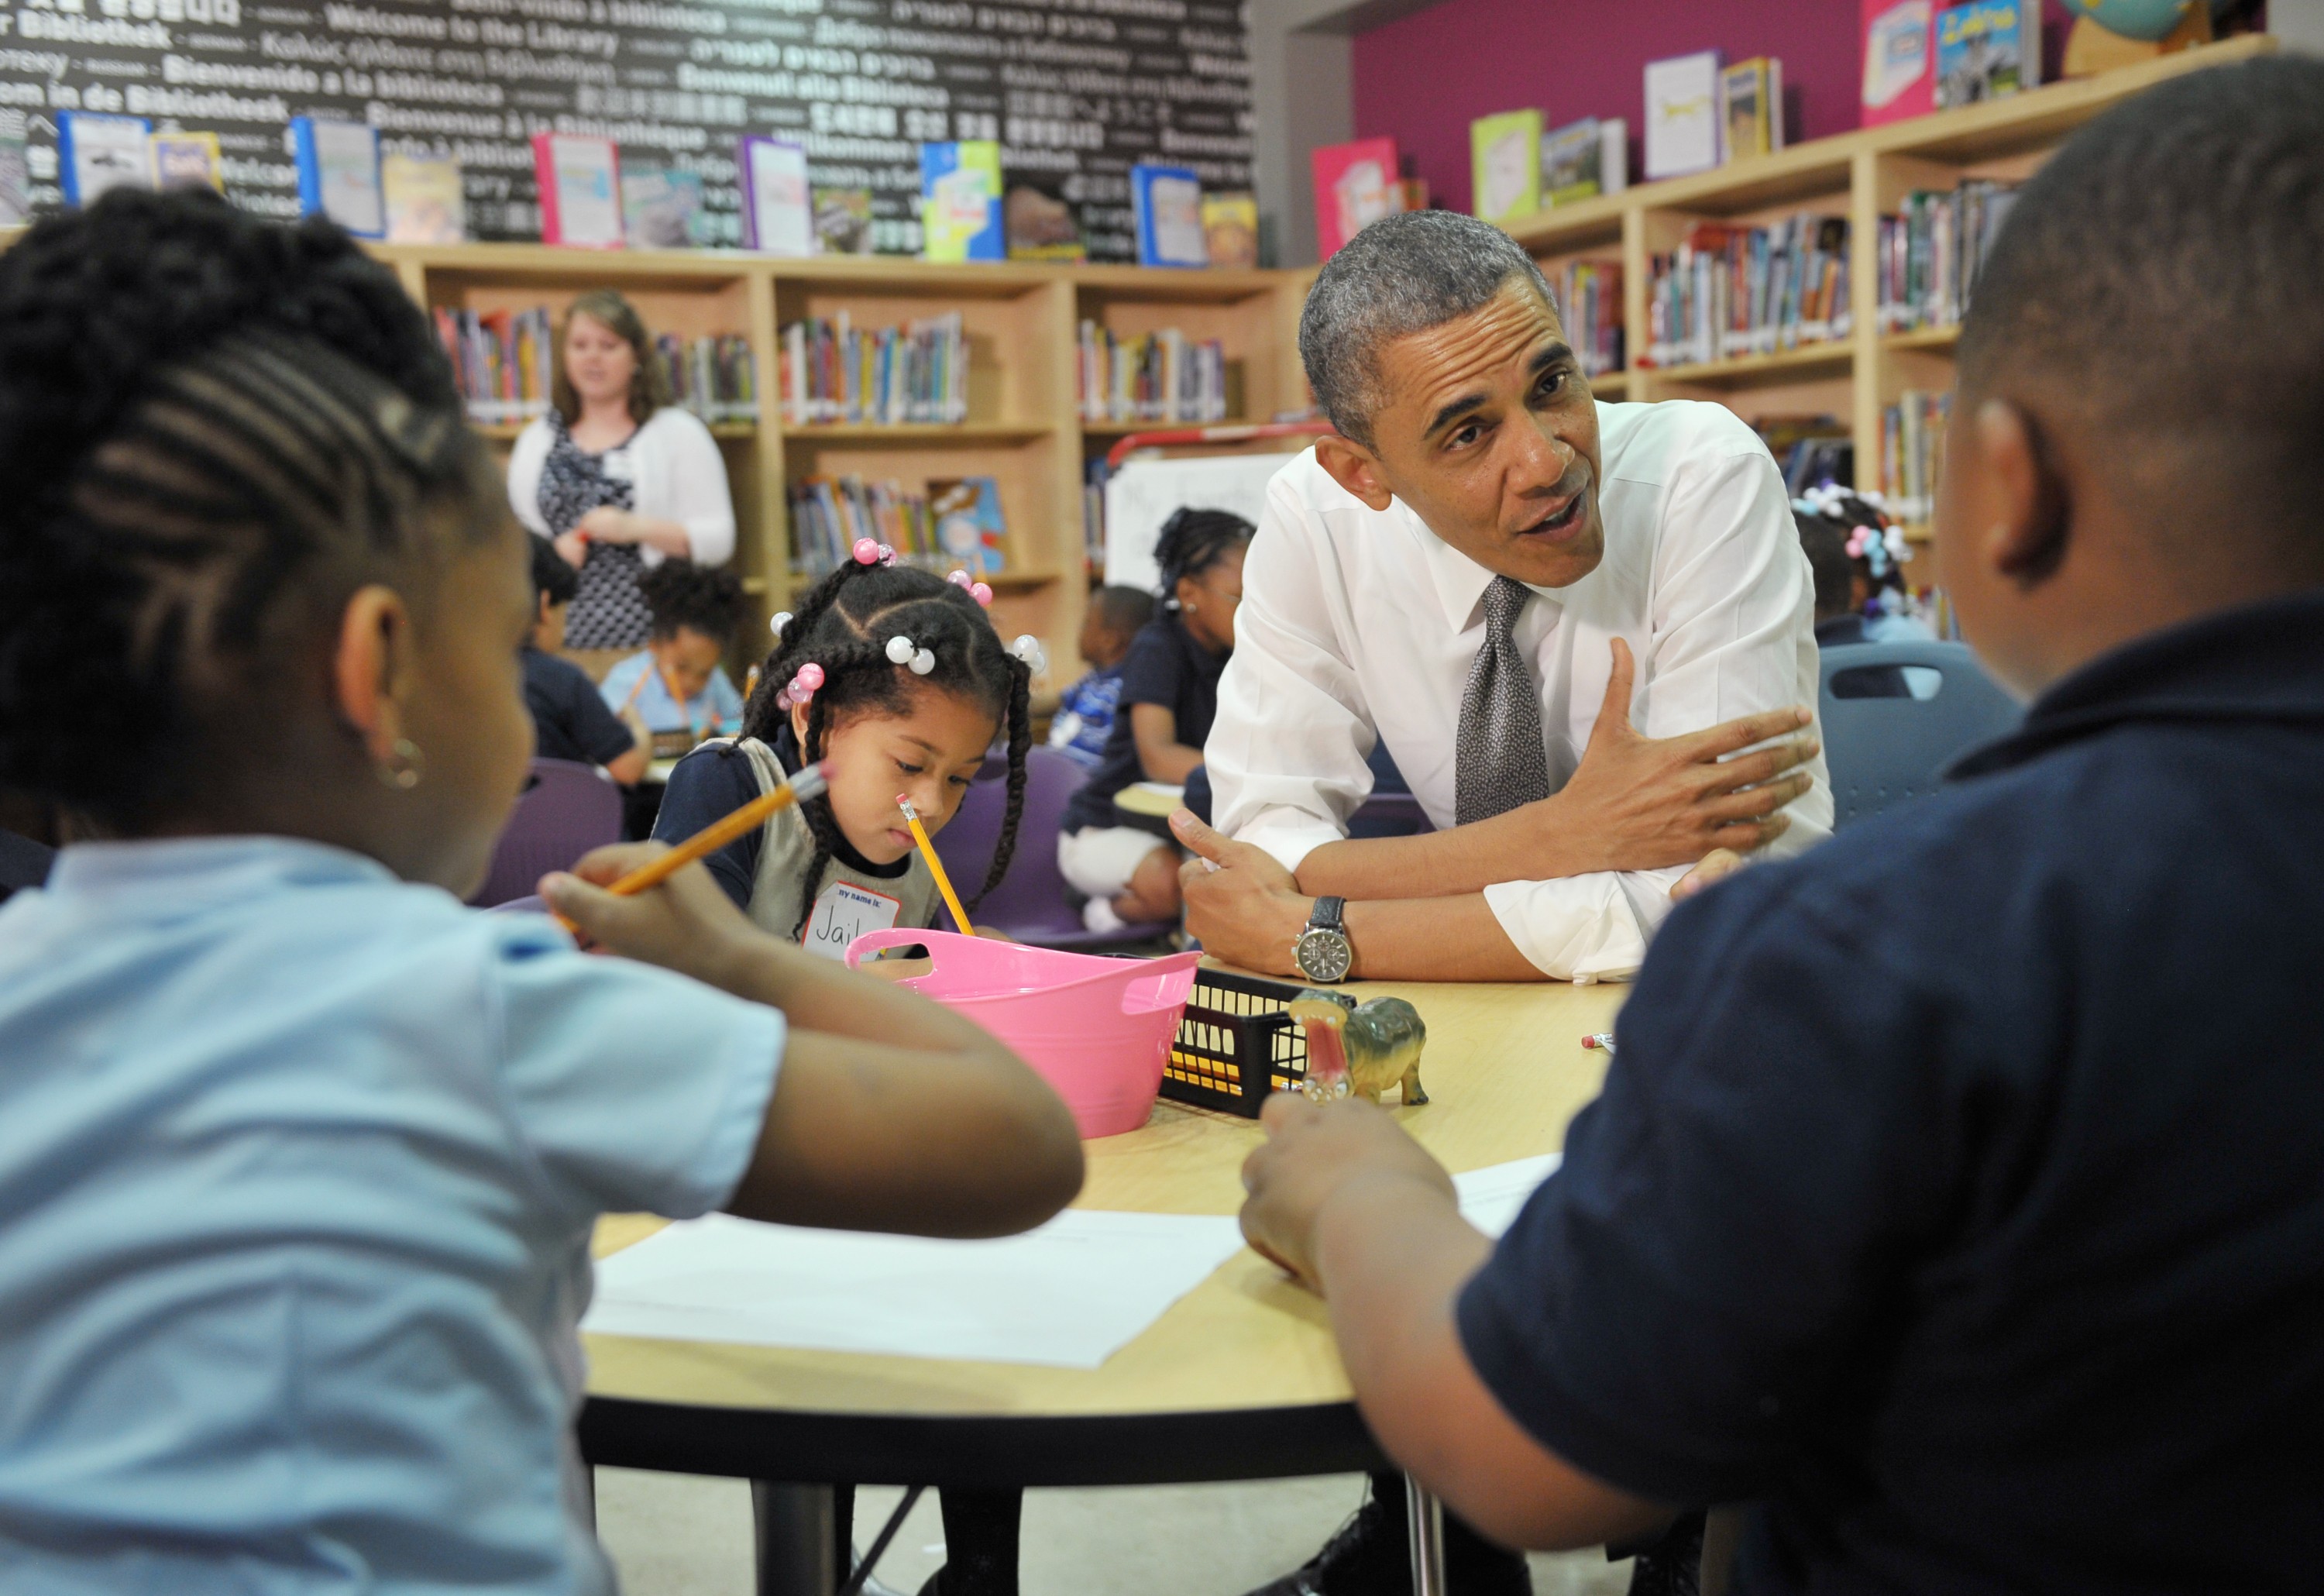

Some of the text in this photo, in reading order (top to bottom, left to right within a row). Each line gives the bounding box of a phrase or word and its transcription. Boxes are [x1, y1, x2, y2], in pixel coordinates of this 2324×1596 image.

[17, 9, 173, 50] Bibliothek
[323, 4, 446, 36] Welcome
[451, 15, 479, 43] to
[480, 16, 524, 45] the
[527, 22, 619, 59] Library
[162, 53, 319, 94] Bienvenido
[344, 67, 373, 97] la
[375, 71, 504, 106] biblioteca
[125, 84, 290, 122] Bibliotheek
[366, 101, 503, 134] Bienvenue
[851, 893, 871, 905] name
